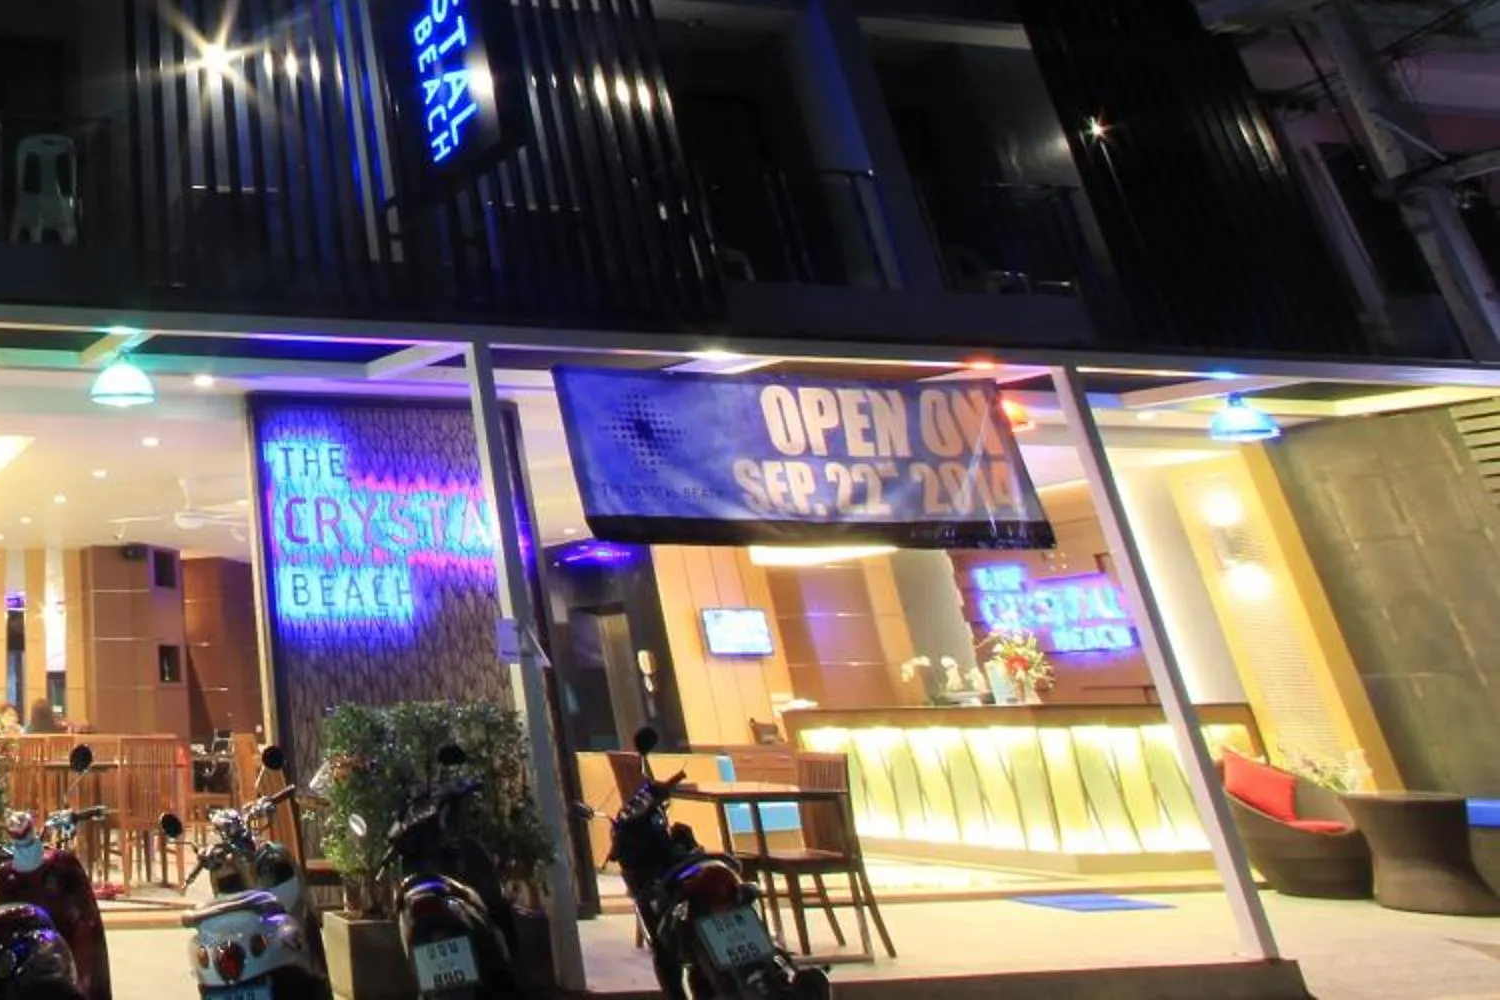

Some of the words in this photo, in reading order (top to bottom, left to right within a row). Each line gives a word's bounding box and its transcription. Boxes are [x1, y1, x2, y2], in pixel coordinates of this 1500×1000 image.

[414, 15, 451, 163] BEACH
[759, 384, 911, 457] OPEN
[919, 388, 1005, 457] ON
[279, 446, 347, 479] THE
[825, 462, 899, 515] 22
[908, 461, 1018, 513] 2014
[284, 495, 493, 547] CRYSTA
[292, 573, 414, 607] BEACH
